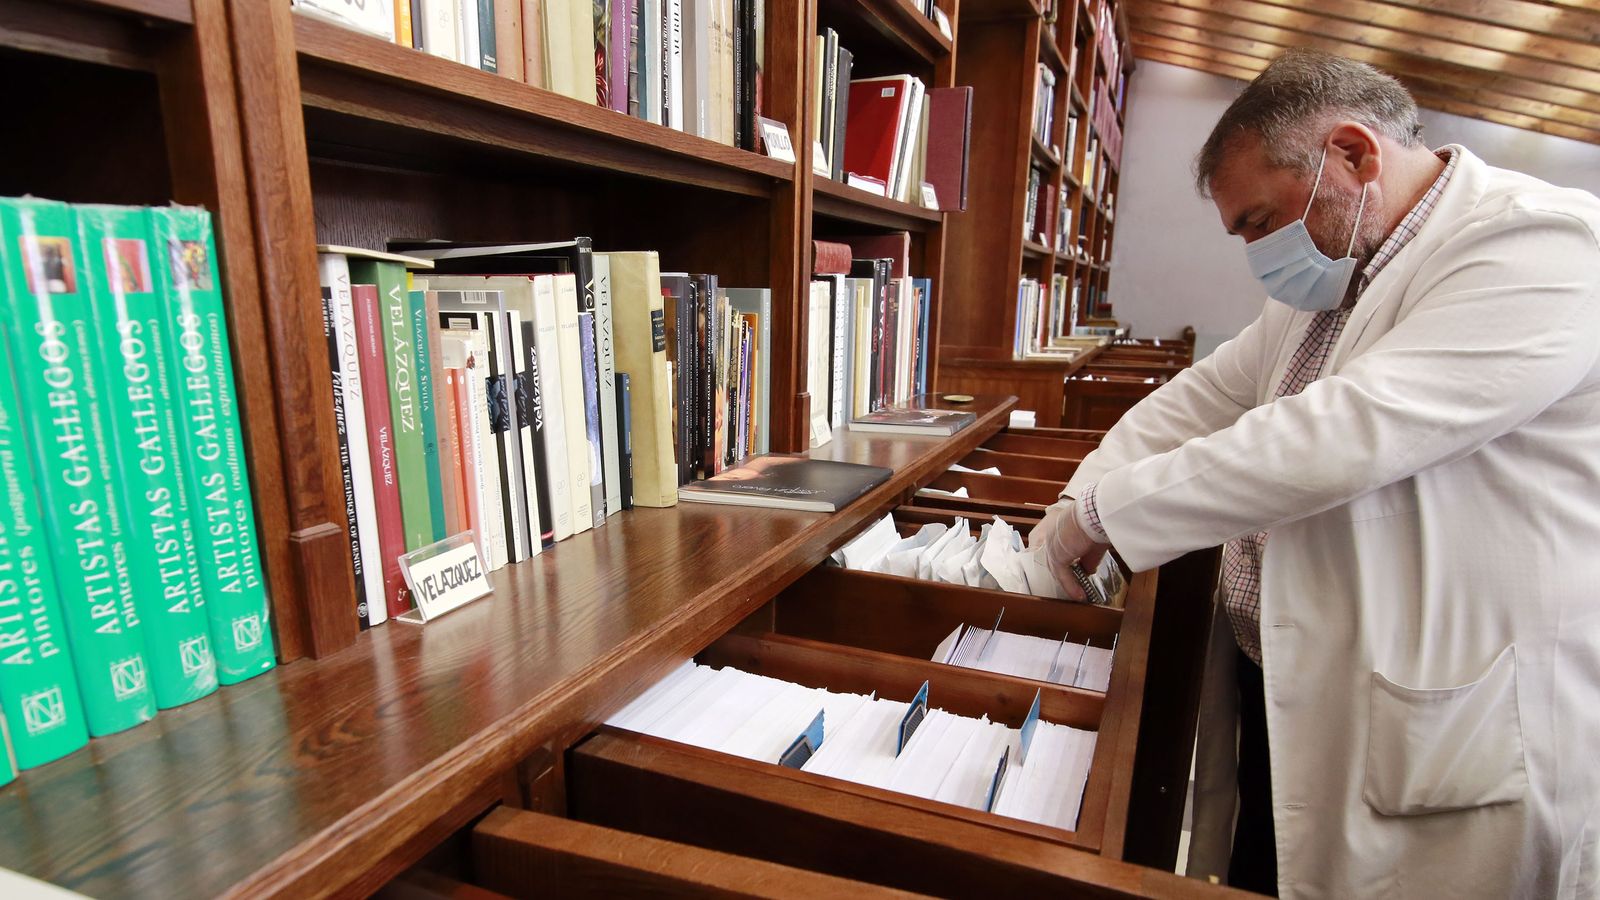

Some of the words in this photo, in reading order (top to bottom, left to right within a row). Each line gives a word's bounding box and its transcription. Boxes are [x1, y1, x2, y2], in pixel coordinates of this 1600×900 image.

[115, 320, 166, 475] GALLEGOS
[176, 314, 222, 461] GALLEGOS
[388, 284, 415, 432] VELÁZQUEZ
[530, 345, 544, 432] Velázquez
[34, 320, 92, 487] GALLEGOS
[332, 371, 347, 437] Velázquez
[339, 443, 348, 465] THE
[342, 466, 356, 523] TECHNIQUE
[69, 499, 122, 634] ARTISTAS
[146, 487, 191, 614] ARTISTAS
[180, 519, 205, 608] pintores
[201, 473, 243, 594] ARTISTAS
[236, 499, 260, 588] pintores
[349, 524, 357, 539] OF
[351, 540, 362, 575] GENIUS
[17, 545, 60, 658] pintores
[111, 541, 141, 628] pintores
[416, 555, 482, 604] VELAZQUEZ
